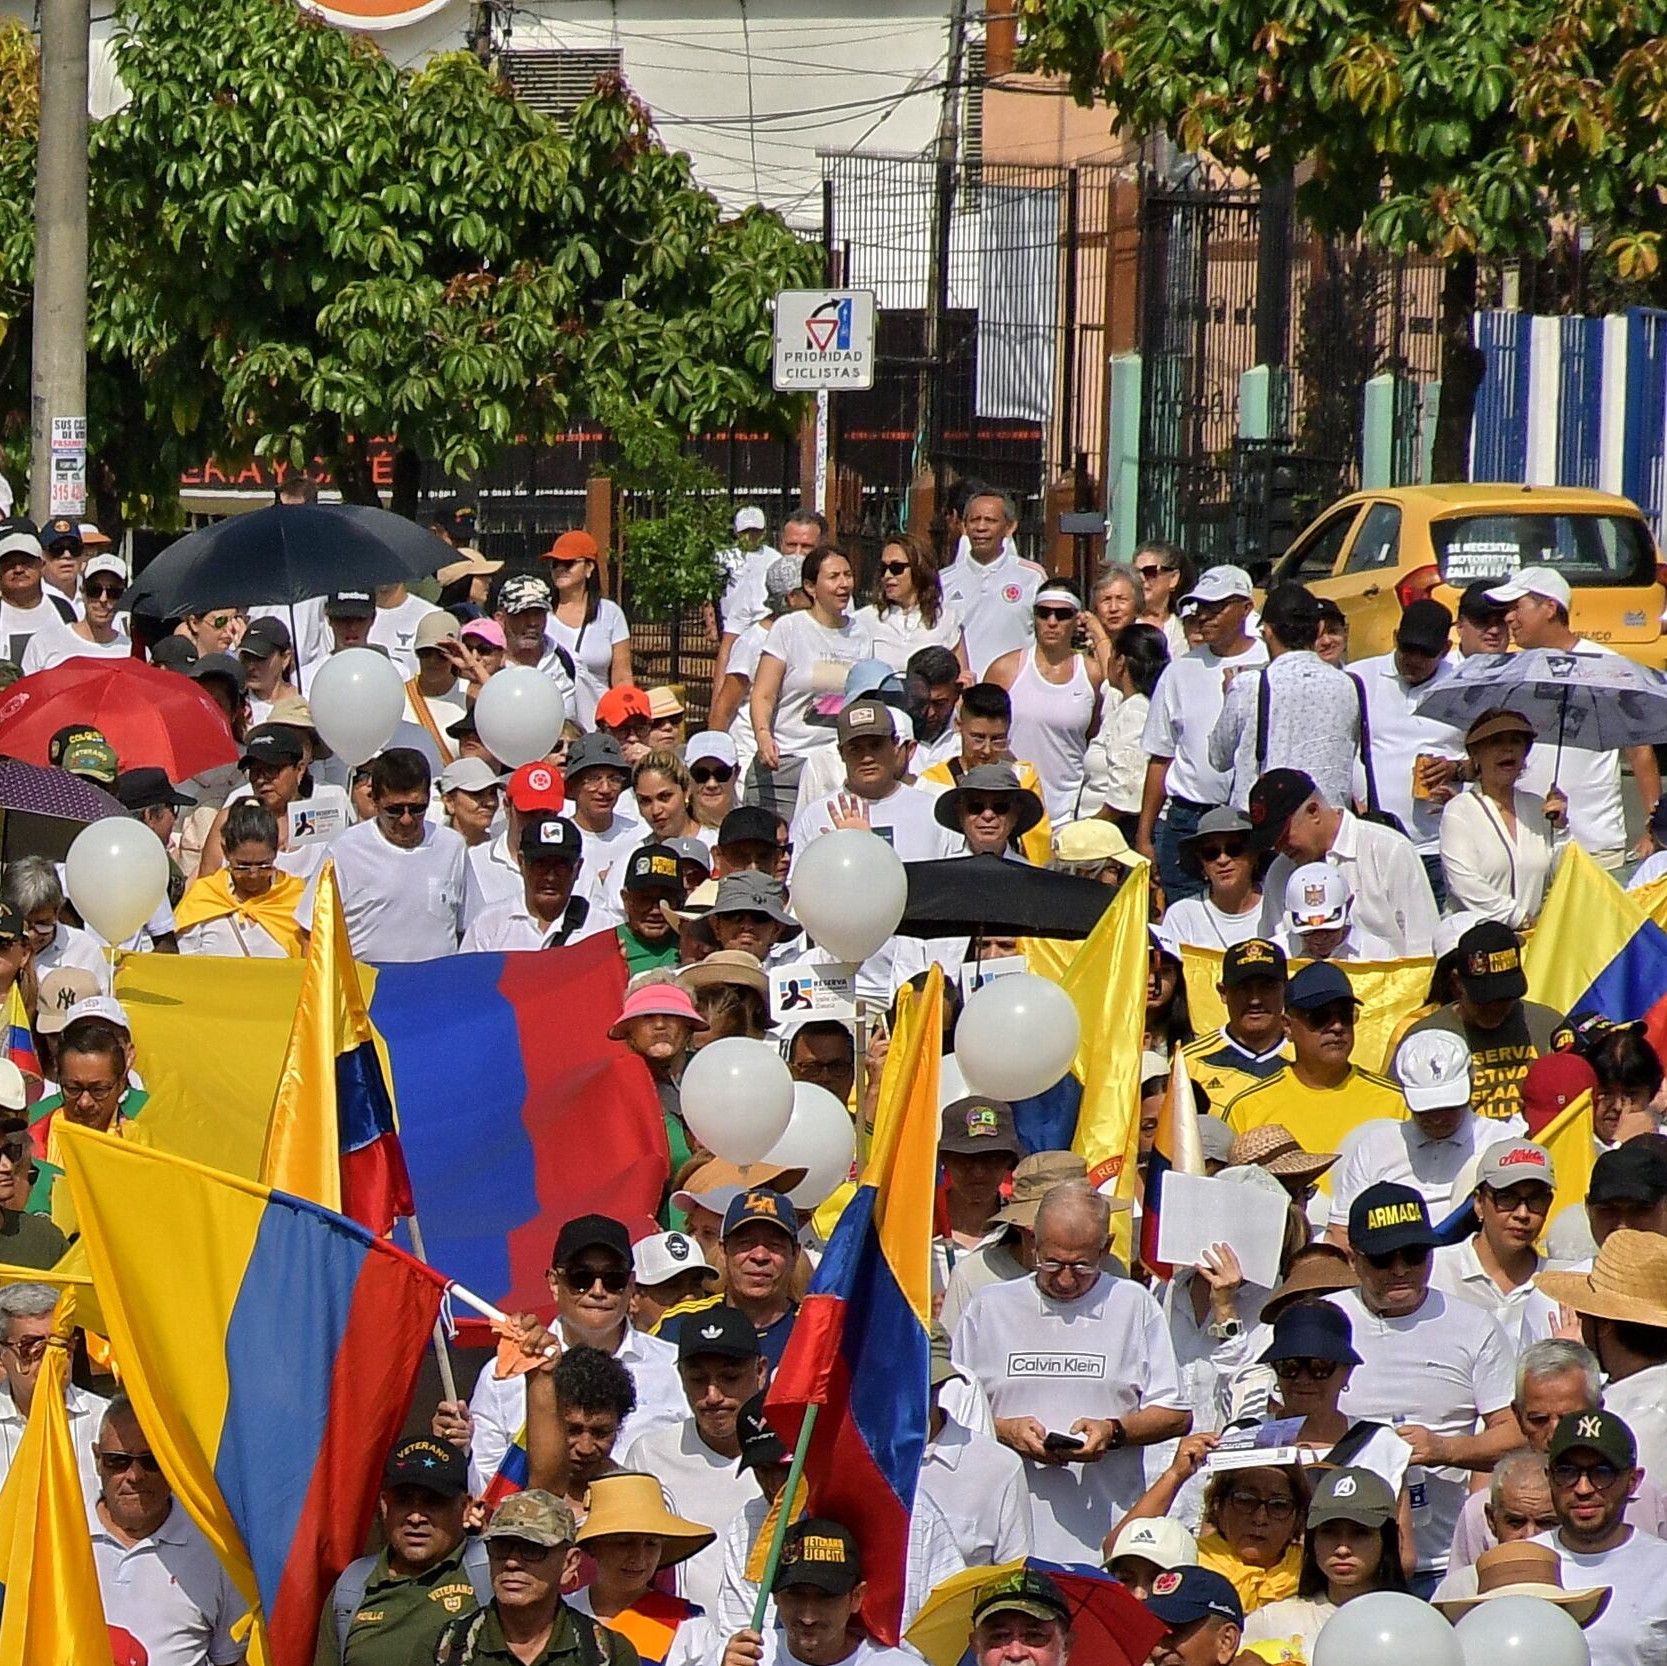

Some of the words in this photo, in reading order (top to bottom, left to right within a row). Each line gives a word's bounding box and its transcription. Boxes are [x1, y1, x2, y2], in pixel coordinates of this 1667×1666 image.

[784, 350, 862, 362] PRIORIDAD
[786, 367, 860, 379] CICLISTAS
[813, 979, 846, 987] RESERVA
[1368, 1202, 1422, 1230] ARMADA
[1013, 1358, 1060, 1374] Calvin
[1062, 1359, 1099, 1375] Klein
[1577, 1415, 1602, 1438] NY
[395, 1441, 450, 1462] VETERANO
[428, 1584, 475, 1602] VETERANO
